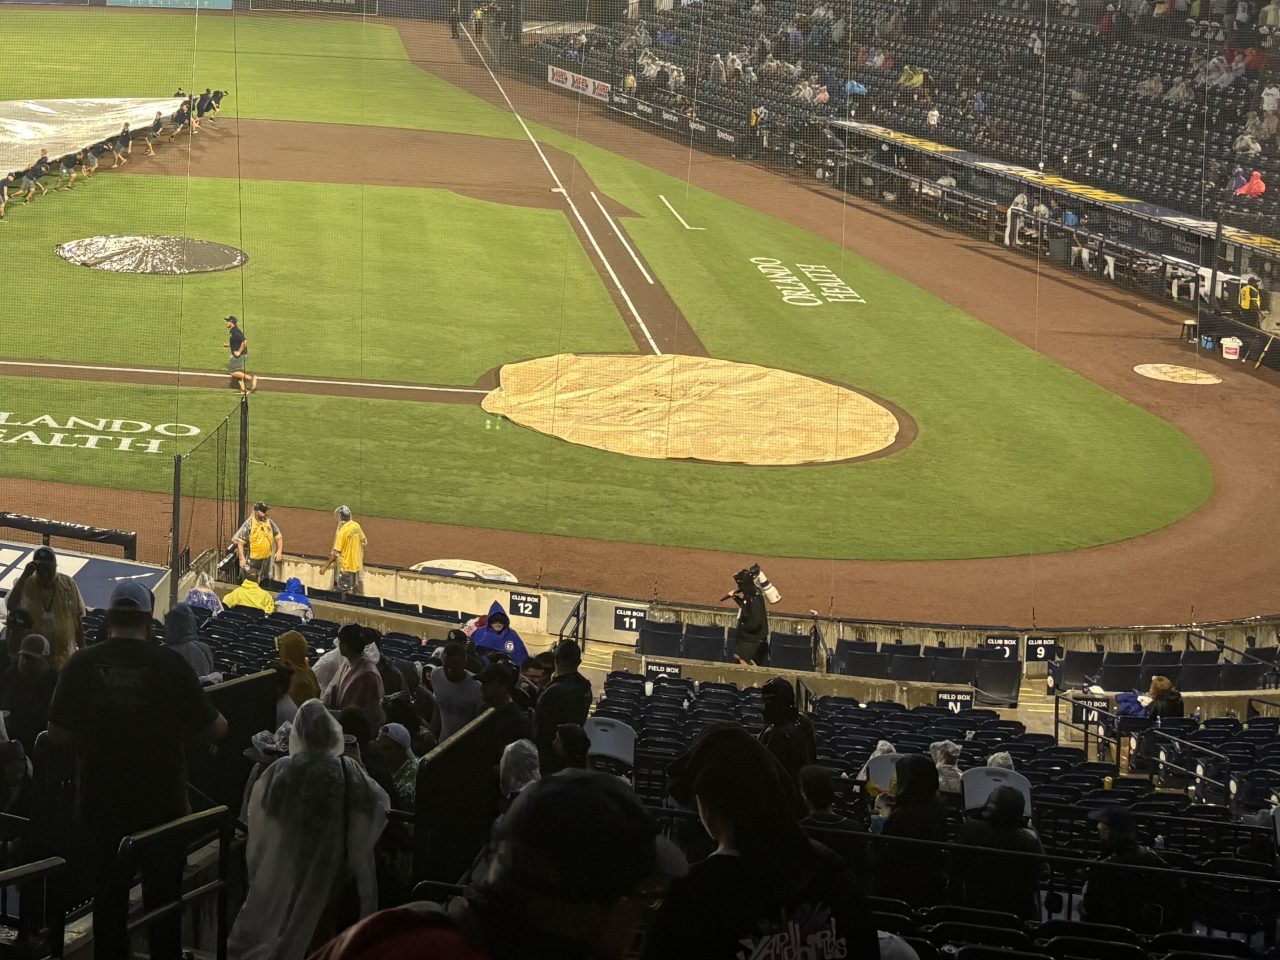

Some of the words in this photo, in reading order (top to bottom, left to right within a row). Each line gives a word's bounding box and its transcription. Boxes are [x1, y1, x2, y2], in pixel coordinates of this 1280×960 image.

[750, 257, 823, 306] ORLANDO
[796, 263, 867, 304] HEALTH
[517, 603, 533, 615] 12
[623, 617, 637, 628] 11
[1036, 646, 1046, 658] 9
[948, 701, 961, 714] N
